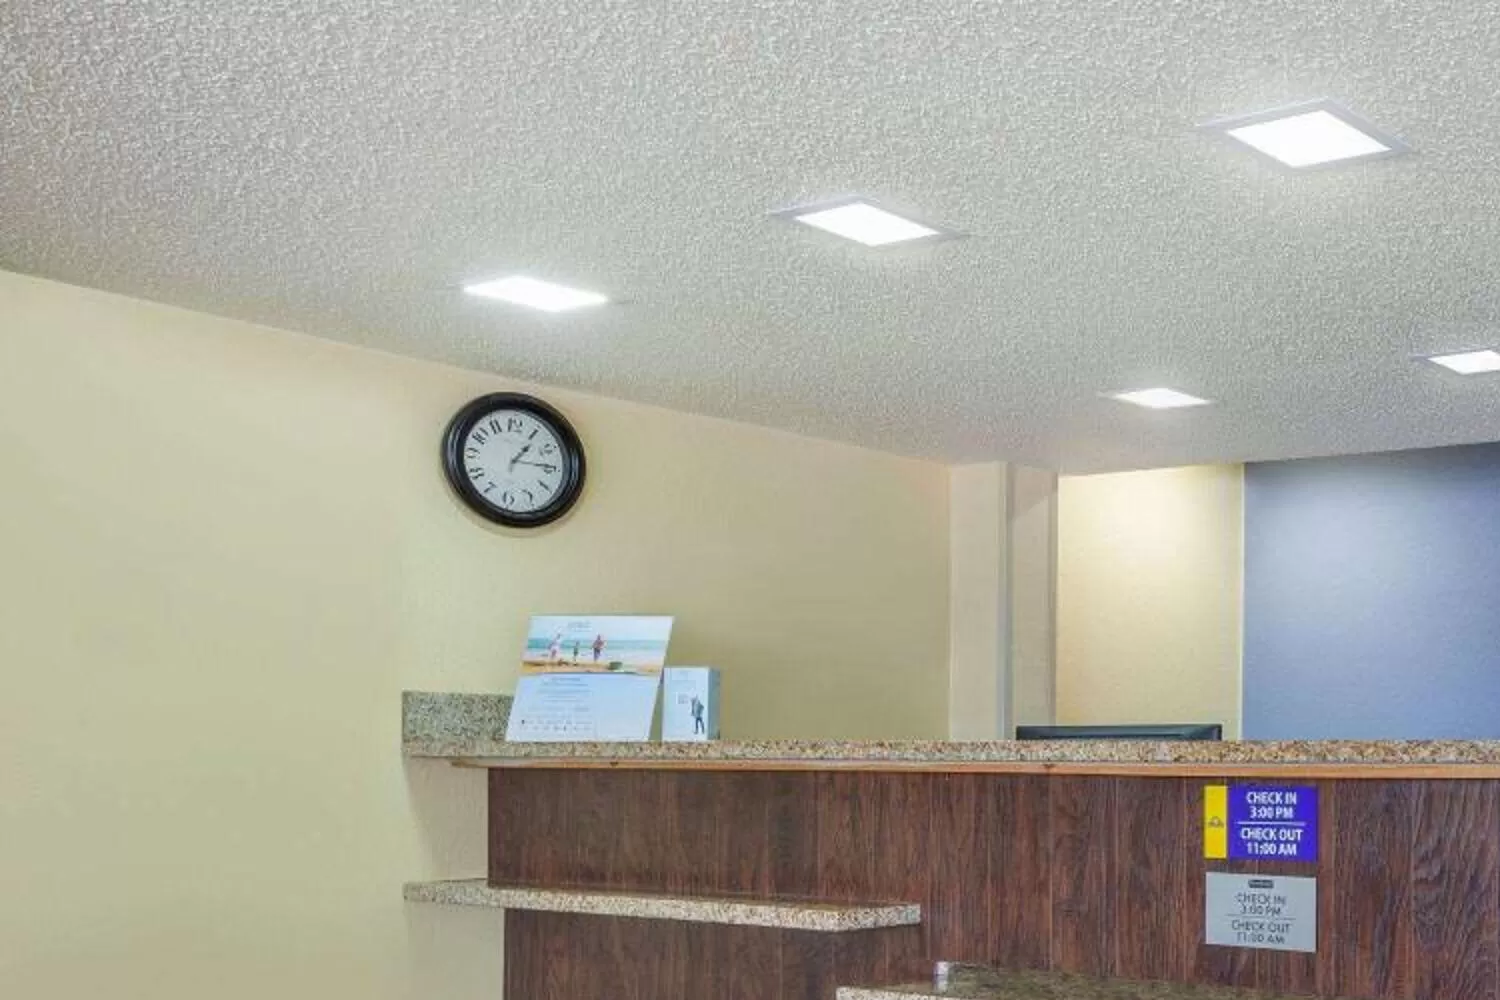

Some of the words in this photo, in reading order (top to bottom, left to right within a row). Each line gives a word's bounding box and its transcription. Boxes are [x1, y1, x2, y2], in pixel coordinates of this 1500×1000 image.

[1246, 791, 1283, 804] CHECK
[1285, 791, 1297, 804] IN
[1250, 806, 1274, 818] 3:00
[1275, 806, 1294, 819] PM
[1240, 828, 1278, 841] CHECK
[1279, 829, 1304, 841] OUT
[1247, 842, 1277, 855] 11:00
[1278, 843, 1297, 856] AM
[1235, 892, 1271, 905] CHECK
[1232, 919, 1266, 931] CHECK
